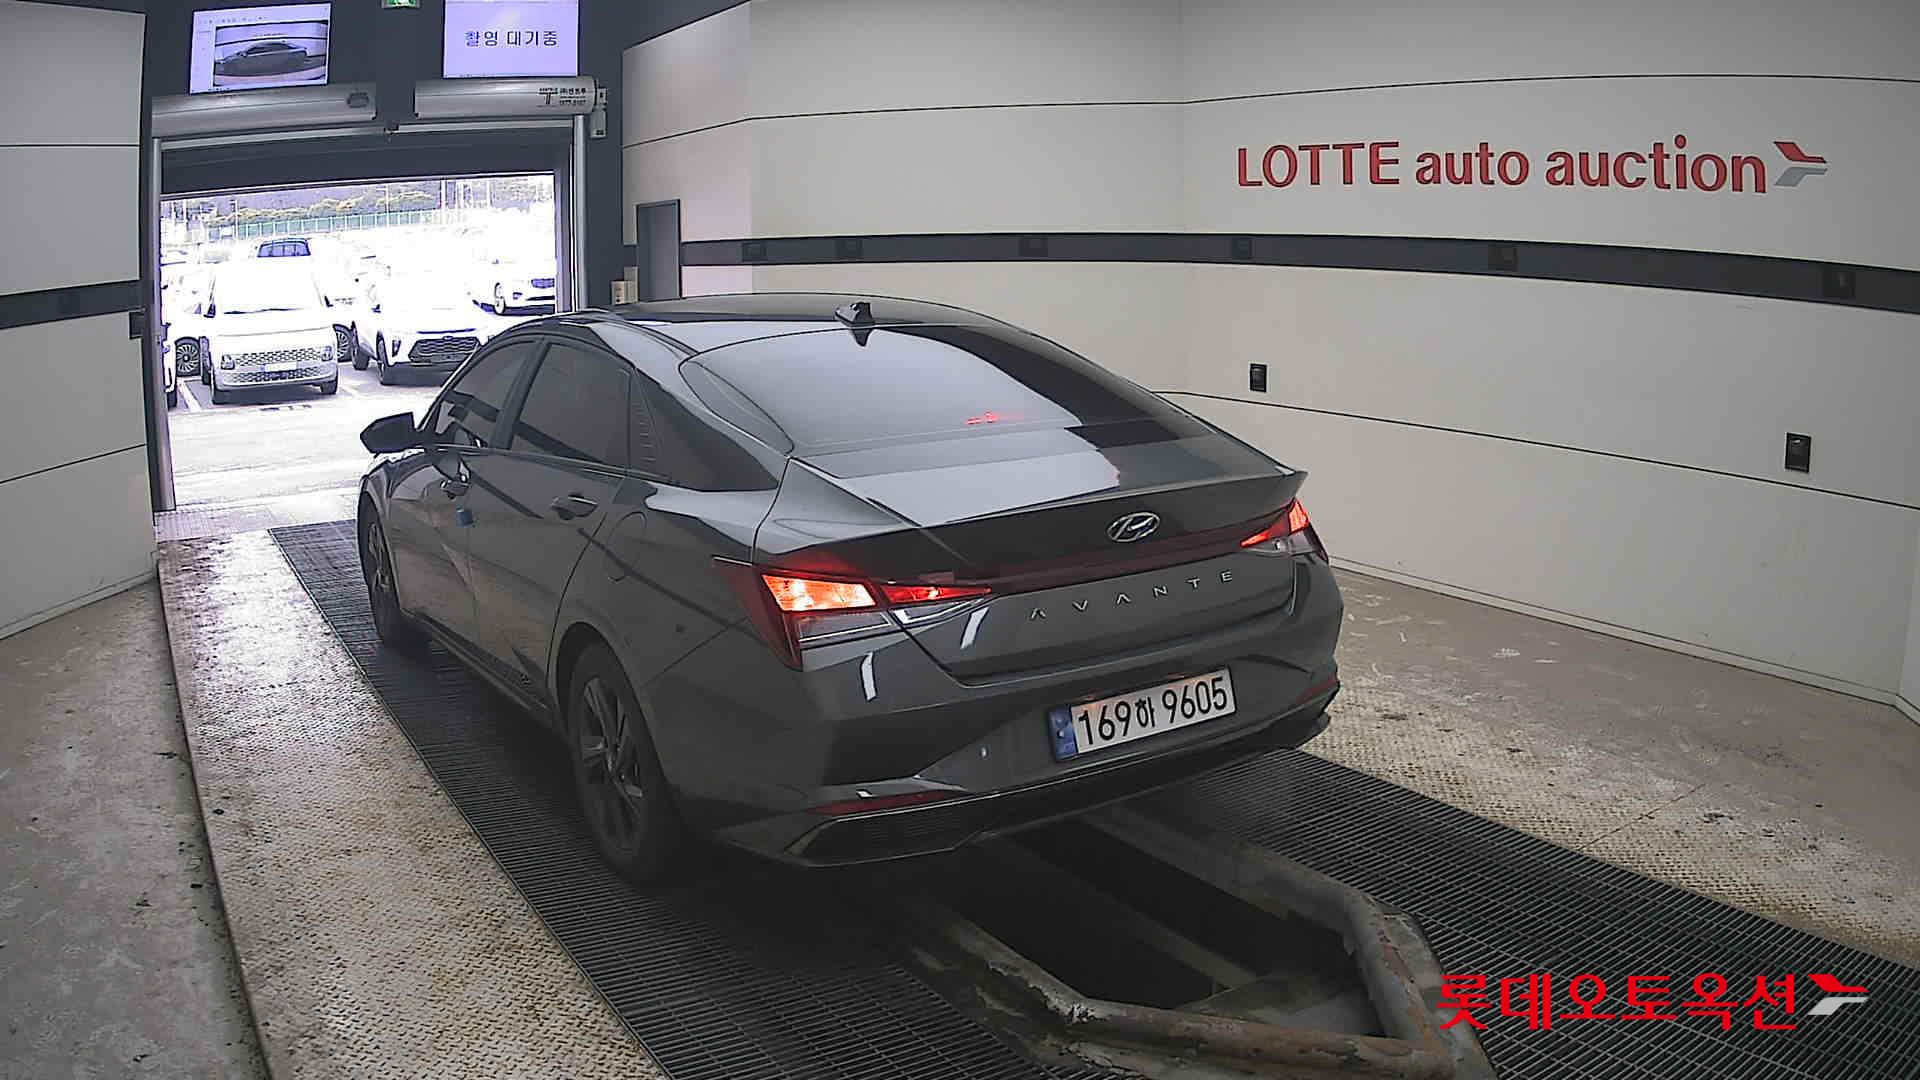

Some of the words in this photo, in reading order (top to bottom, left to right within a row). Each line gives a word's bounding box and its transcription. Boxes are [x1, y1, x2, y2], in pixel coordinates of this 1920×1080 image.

[464, 31, 498, 47] 촬영
[507, 30, 557, 46] 대기중
[1238, 141, 1400, 187] LOTTE
[1414, 142, 1529, 186] auto
[1545, 134, 1767, 194] auction
[1029, 570, 1234, 620] AVANTE
[1078, 696, 1156, 746] 169하
[1162, 676, 1228, 724] 9605
